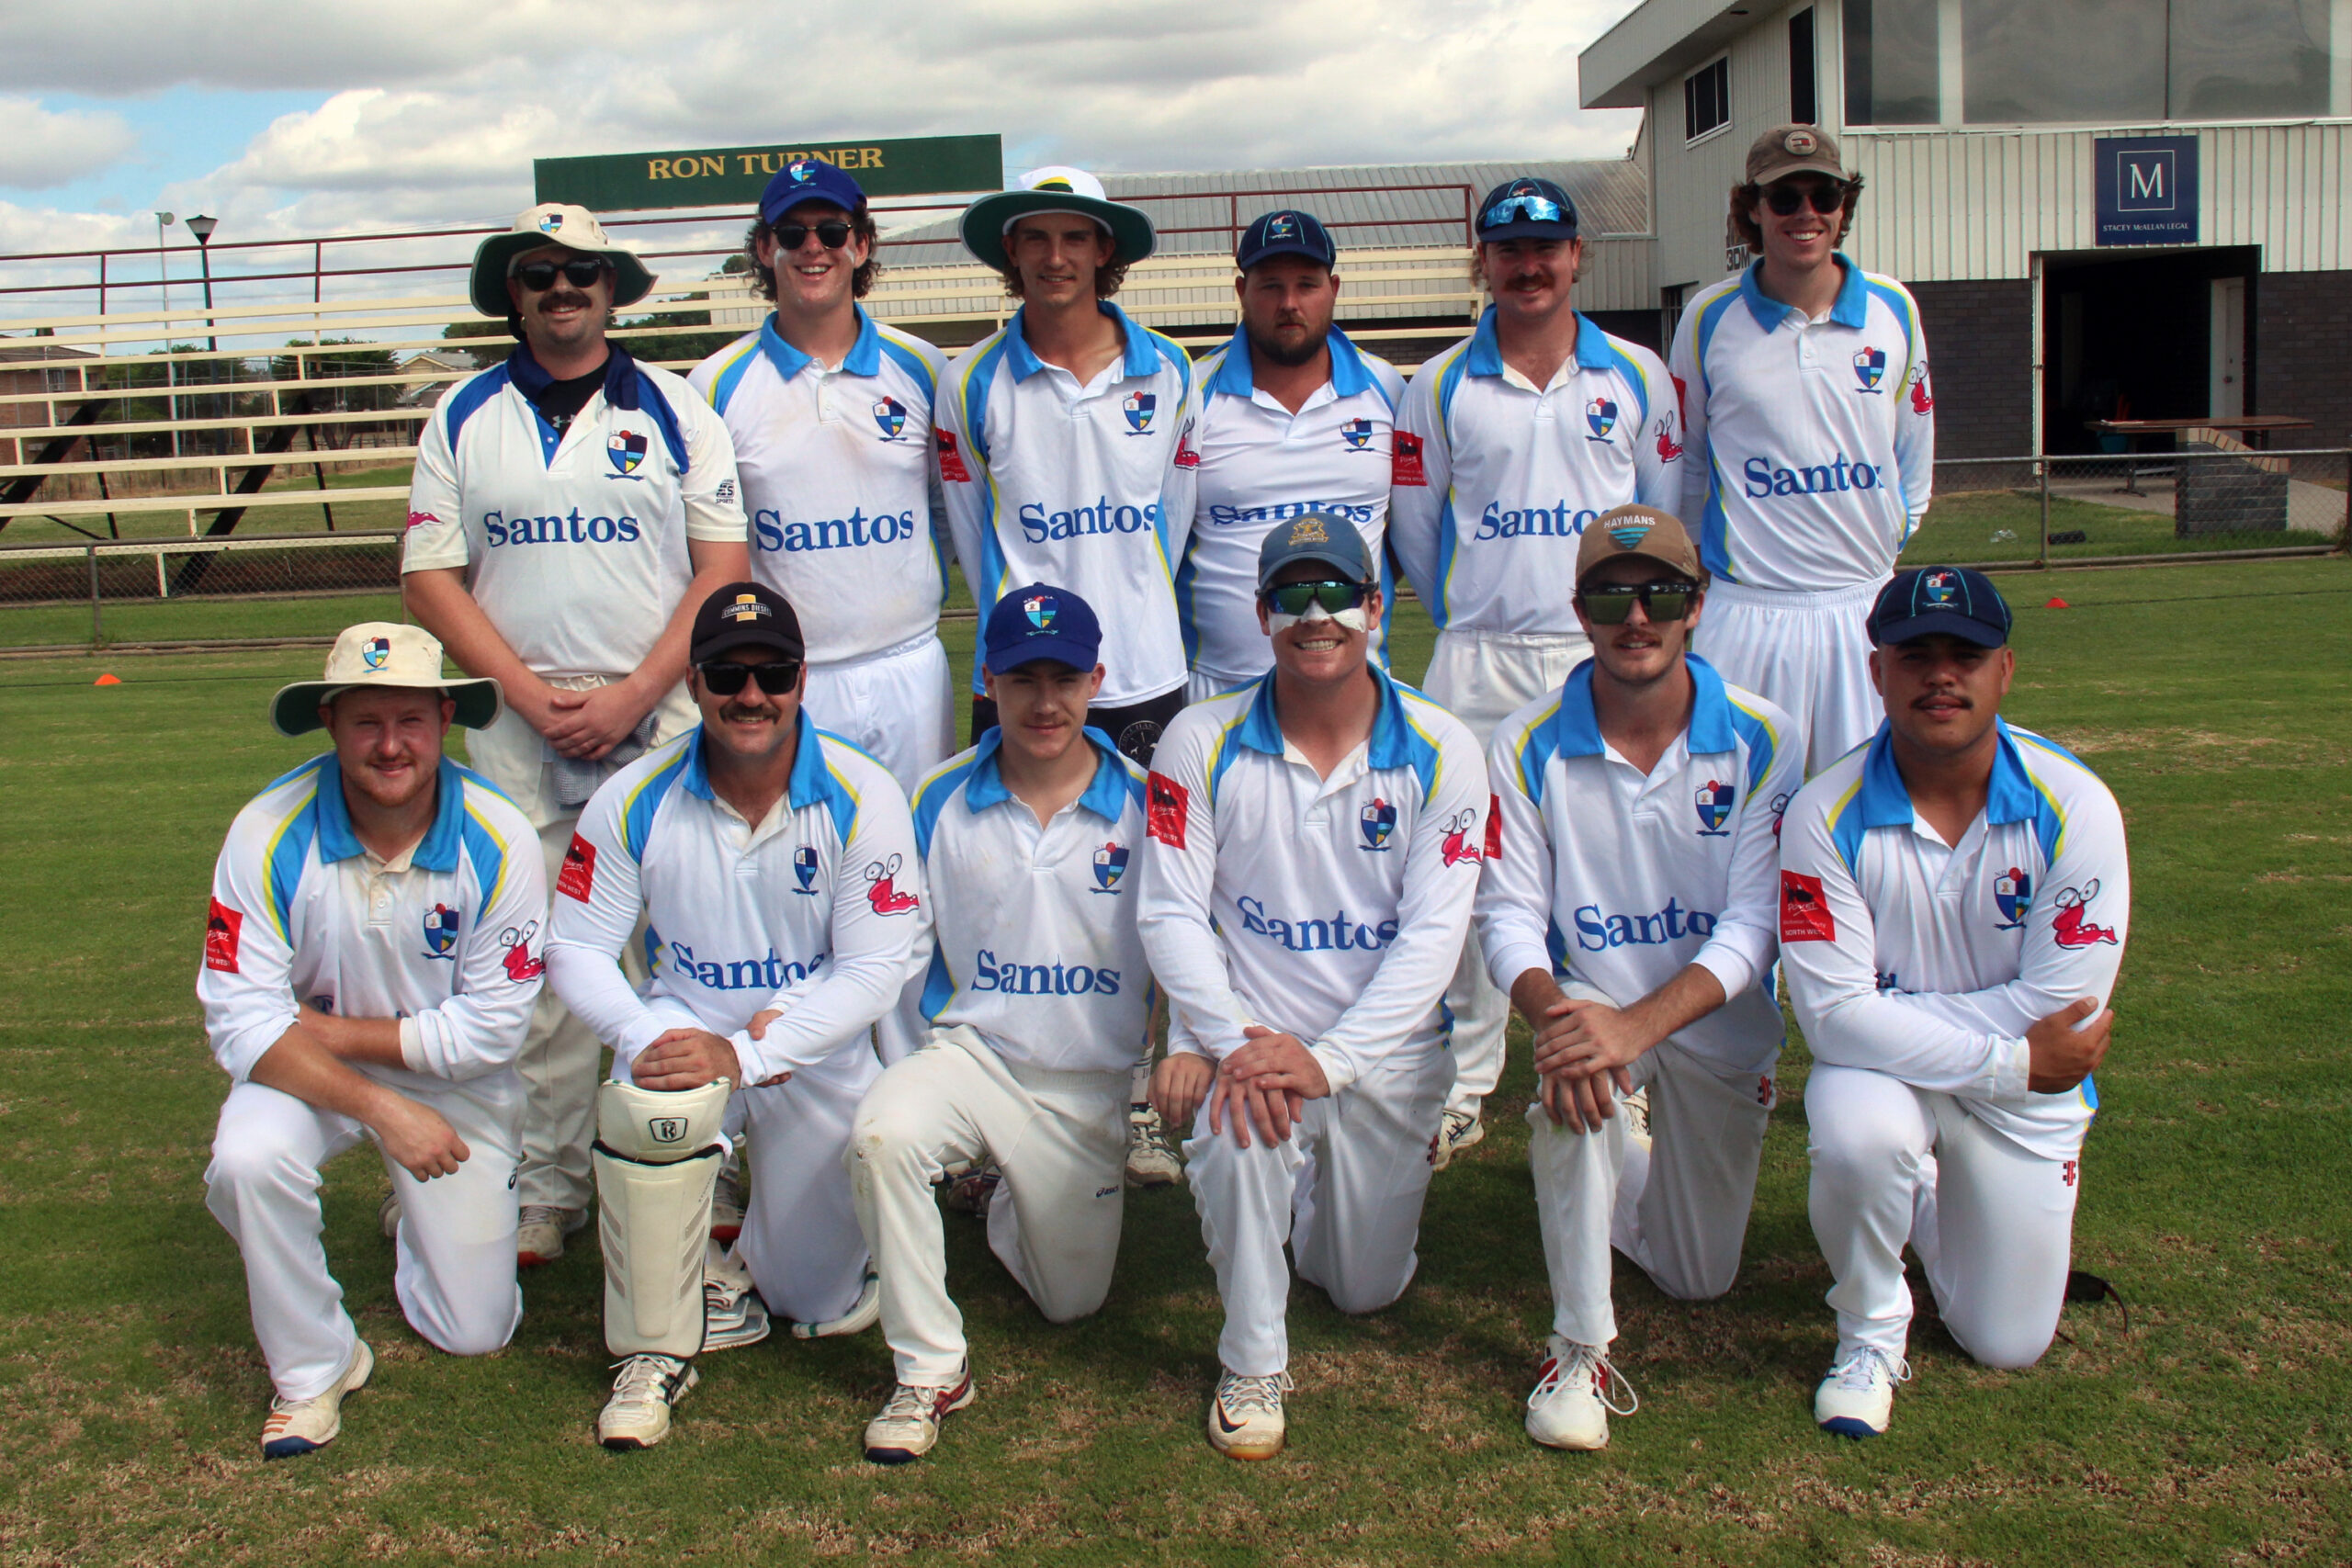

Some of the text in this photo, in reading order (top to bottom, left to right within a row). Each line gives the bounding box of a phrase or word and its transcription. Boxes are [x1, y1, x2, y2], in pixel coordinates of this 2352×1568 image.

[648, 154, 726, 181] RON
[2130, 163, 2164, 199] M
[2102, 224, 2132, 232] STACEY
[2166, 222, 2189, 231] LEGAL
[483, 506, 641, 548] Santos
[754, 506, 914, 552] Santos
[1019, 494, 1156, 545] Santos
[1474, 499, 1610, 542] Santo
[1603, 514, 1657, 529] HAYMANS
[567, 884, 582, 897] WEST
[1237, 895, 1399, 953] Santos
[1573, 897, 1717, 953] Santo
[1784, 928, 1805, 936] NORTH
[215, 957, 231, 967] WEST
[970, 948, 1122, 996] Santos
